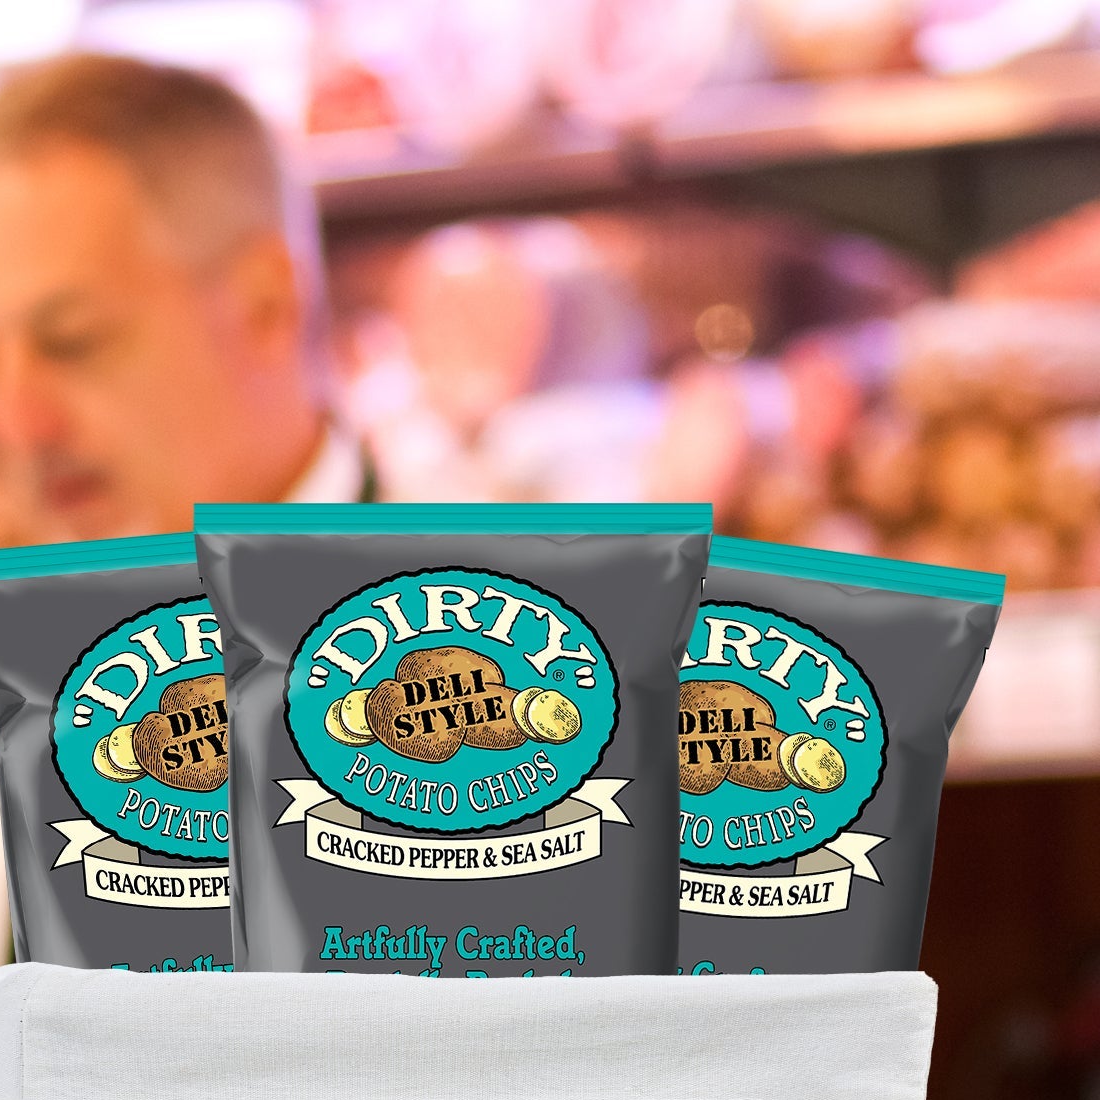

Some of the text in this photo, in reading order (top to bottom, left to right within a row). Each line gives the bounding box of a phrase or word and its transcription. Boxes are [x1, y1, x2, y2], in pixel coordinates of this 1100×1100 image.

[402, 669, 487, 707] DELI
[680, 616, 871, 743] RTY"
[393, 696, 506, 739] STYLE
[678, 707, 756, 735] DELI
[162, 730, 228, 771] STY
[344, 750, 558, 815] POTATO CHIPS
[117, 787, 229, 843] POTATO
[723, 796, 815, 850] CHIPS
[317, 830, 586, 869] CRACKED PEPPER & SEA SALT
[95, 869, 185, 898] CRACKED
[728, 885, 745, 906] &
[747, 885, 784, 907] SEA
[786, 881, 835, 906] SALT
[319, 925, 585, 969] Artfully Crafted,
